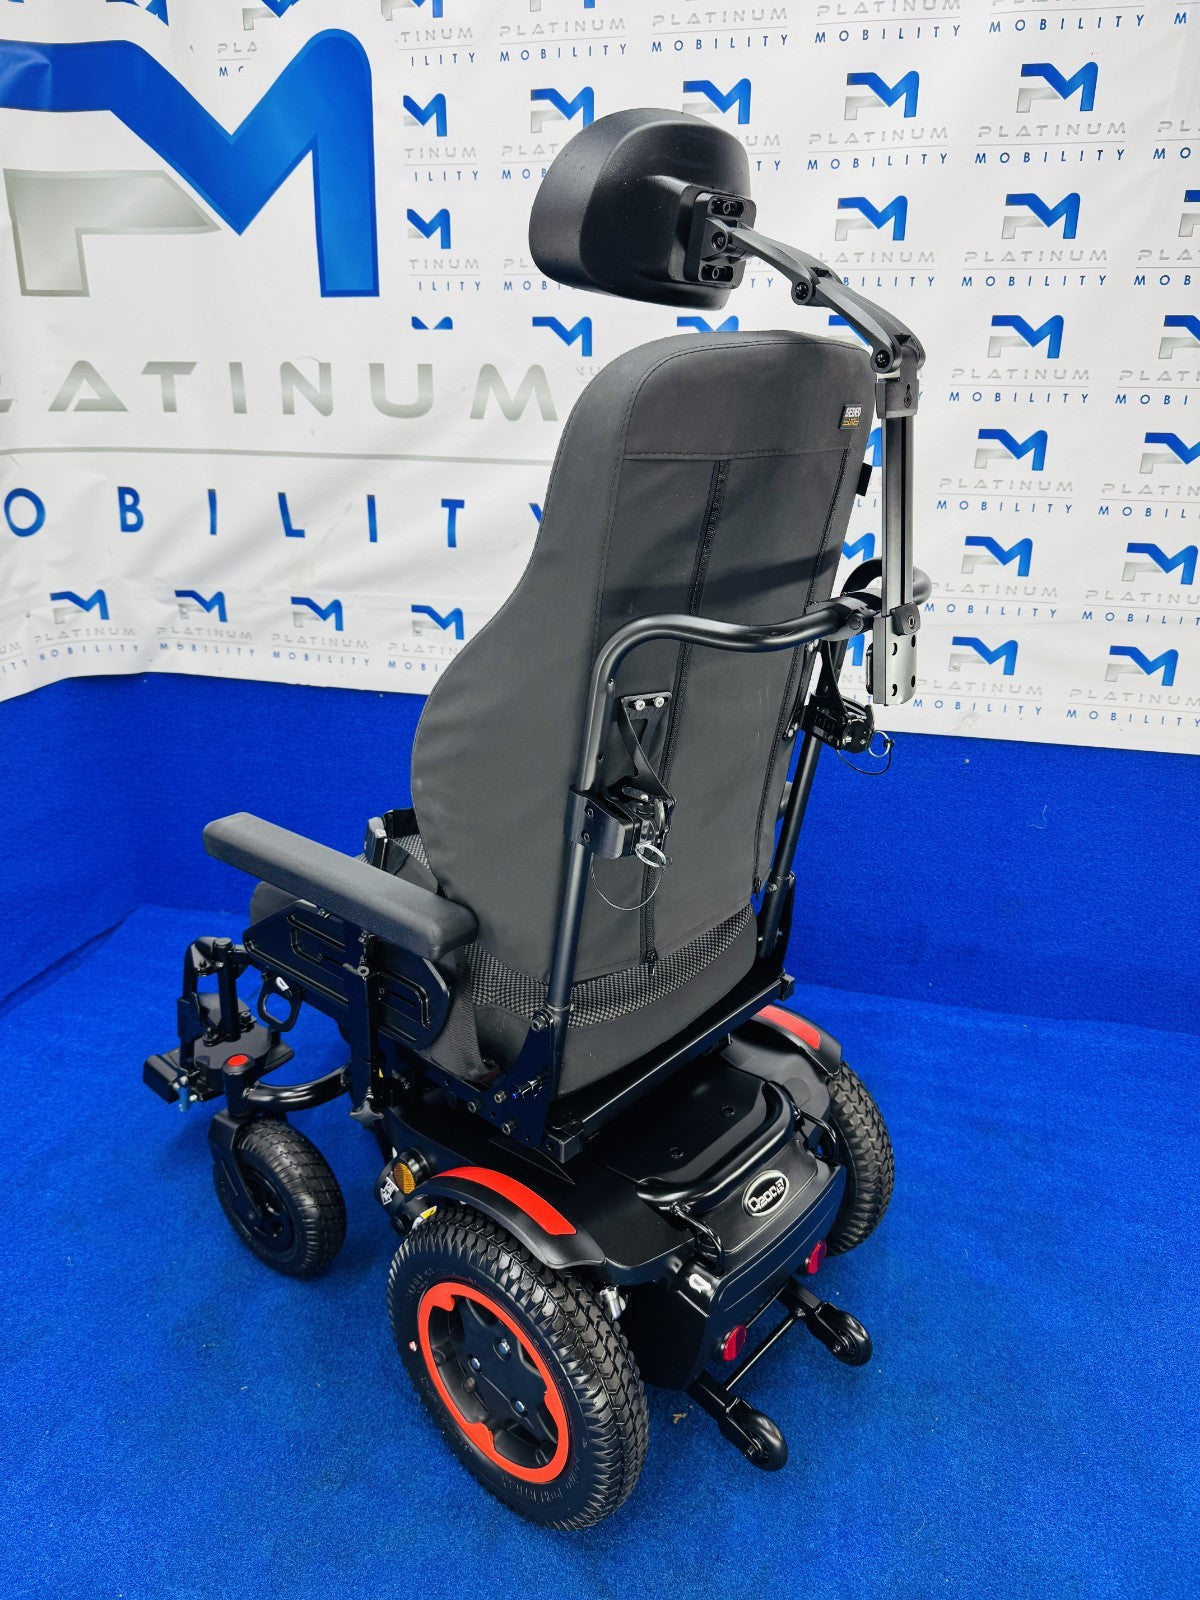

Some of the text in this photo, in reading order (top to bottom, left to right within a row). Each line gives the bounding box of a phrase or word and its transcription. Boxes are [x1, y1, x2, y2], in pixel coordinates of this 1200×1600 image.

[817, 0, 960, 17] PLATINUM
[653, 8, 787, 26] PLATINUM
[989, 14, 1144, 33] MOBILITY
[395, 27, 473, 43] TINUM
[500, 18, 625, 37] PLATINUM
[815, 25, 960, 43] MOBILITY
[652, 34, 788, 52] MOBILITY
[500, 44, 627, 62] MOBILITY
[809, 127, 947, 145] PLATINUM
[978, 122, 1126, 137] PLATINUM
[807, 153, 947, 170] MOBILITY
[975, 149, 1124, 164] MOBILITY
[965, 250, 1107, 262] PLATINUM
[961, 275, 1106, 287] MOBILITY
[952, 369, 1089, 380] PLATINUM
[0, 358, 557, 421] ATINUM
[949, 392, 1088, 403] MOBILITY
[940, 478, 1073, 491] PLATINUM
[937, 500, 1072, 513] MOBILITY
[1098, 506, 1200, 519] MOBIL
[3, 486, 543, 548] OBILIT
[924, 603, 1057, 618] MOBILITY
[272, 650, 370, 667] MOBILITY
[913, 699, 1042, 715] MOBILITY
